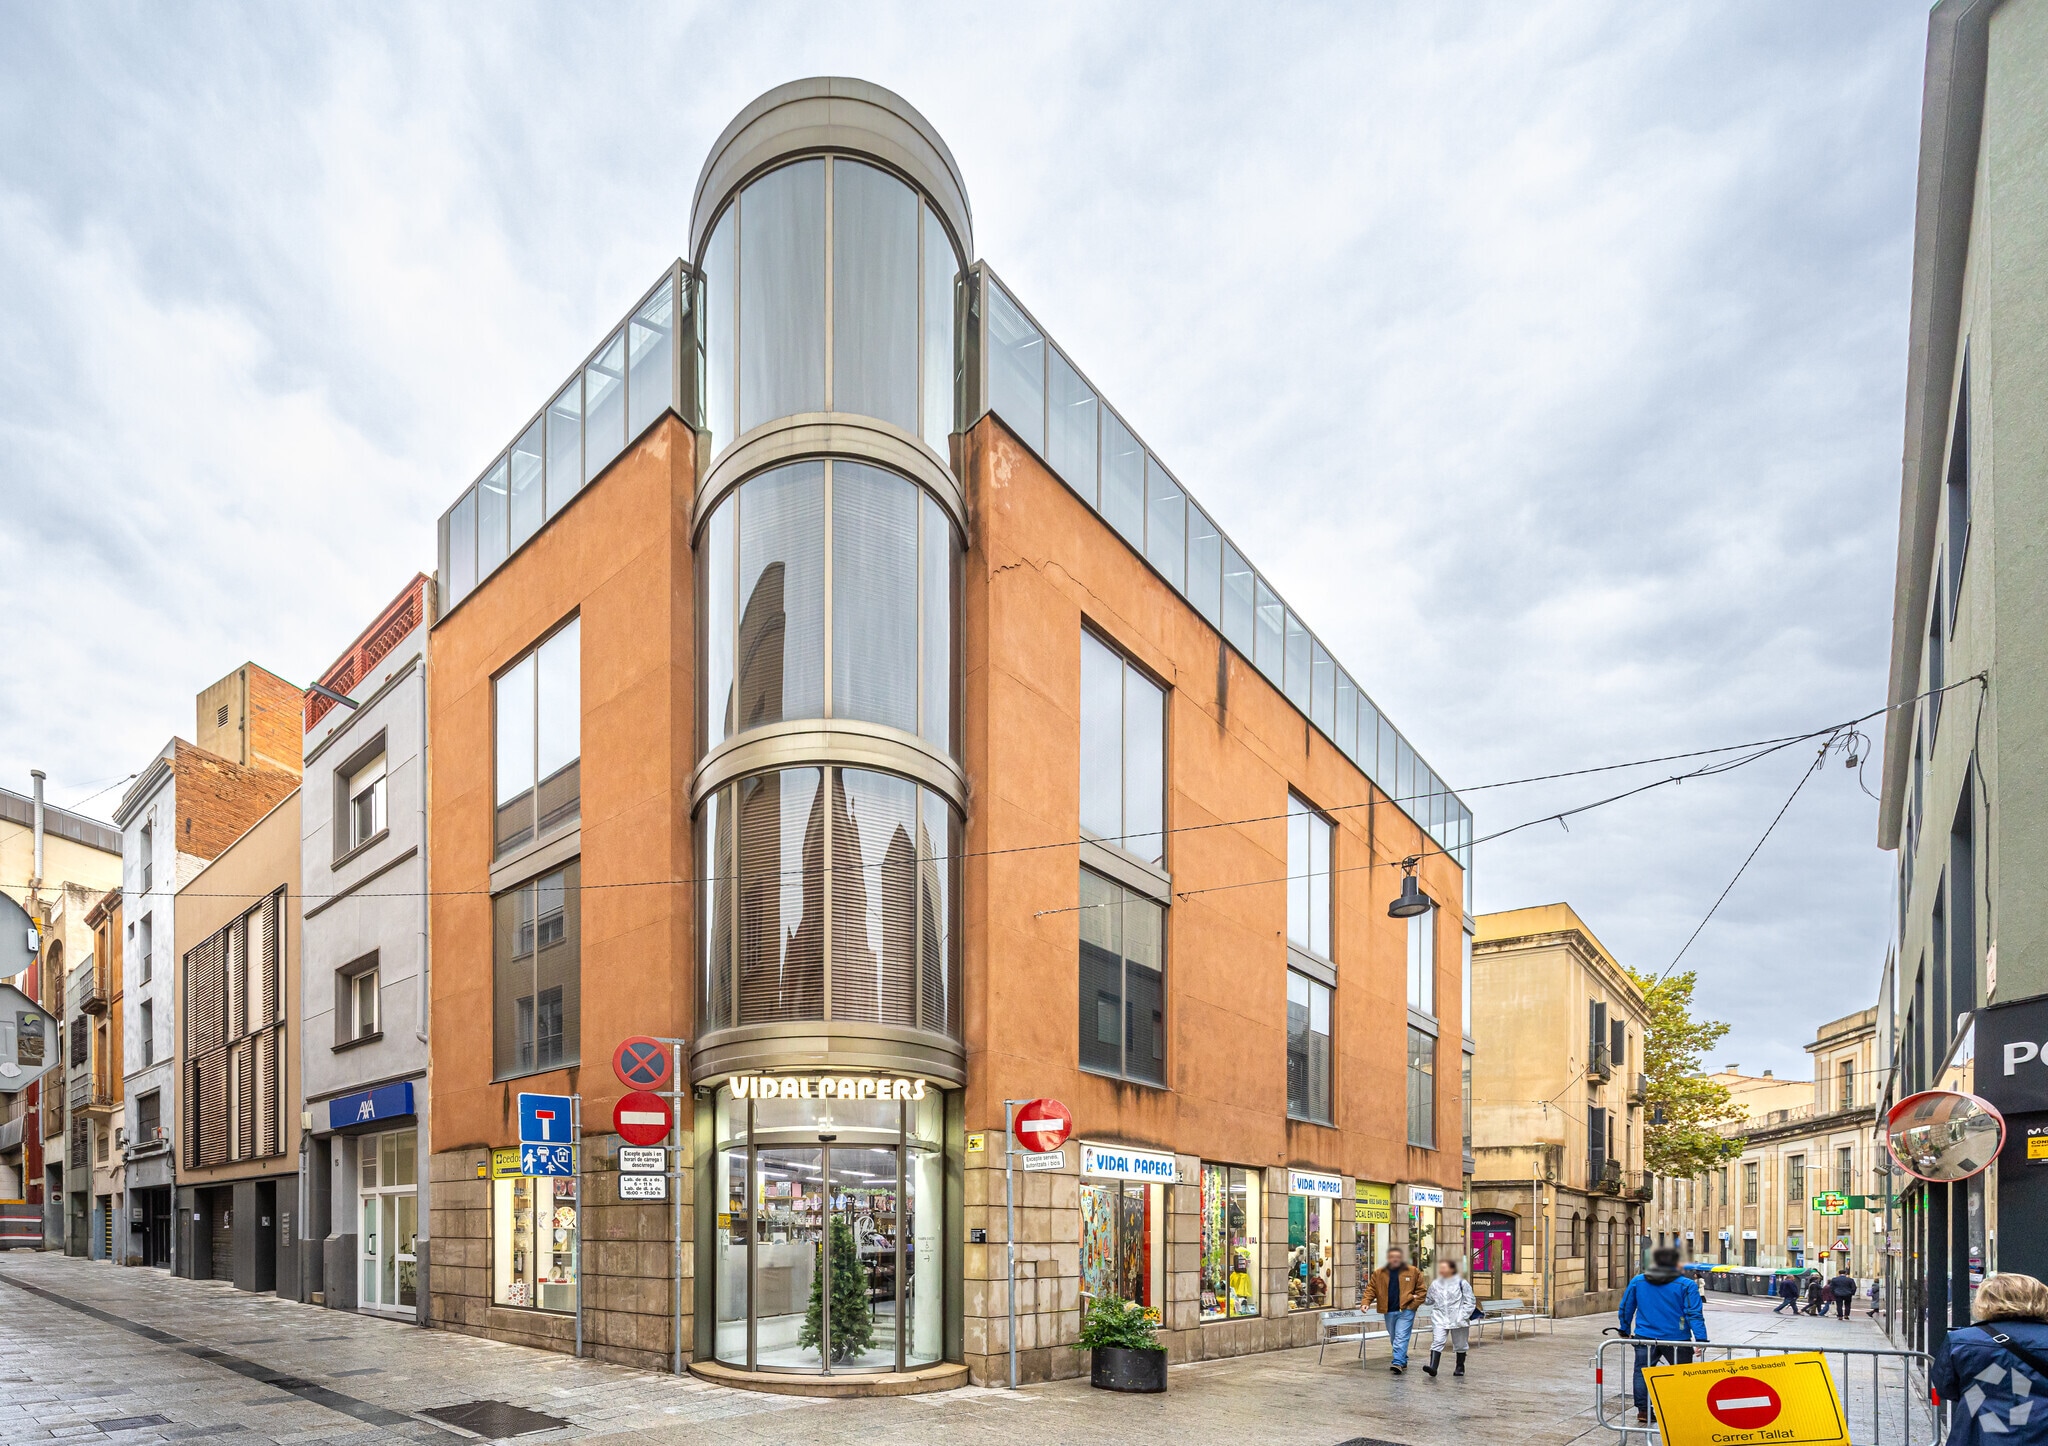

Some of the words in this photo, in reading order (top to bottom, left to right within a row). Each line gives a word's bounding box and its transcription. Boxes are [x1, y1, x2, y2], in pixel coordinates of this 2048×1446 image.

[729, 1076, 814, 1099] VIDAL
[818, 1076, 926, 1101] PAPERS
[356, 1099, 375, 1121] AXA
[1096, 1154, 1129, 1172] VIDAL
[1134, 1158, 1172, 1176] PAPERS
[1297, 1178, 1315, 1190] VIDAL
[1318, 1180, 1340, 1193] PAPERS
[1415, 1192, 1426, 1201] VIDAL
[1428, 1193, 1442, 1203] PAPERS
[1355, 1210, 1367, 1218] OCAL
[1367, 1210, 1374, 1219] EN
[1374, 1211, 1388, 1219] VENDA
[1683, 1367, 1726, 1377] Ajuntament
[1751, 1361, 1786, 1370] Sabadell
[1711, 1432, 1754, 1443] Carrer
[1756, 1429, 1795, 1440] Tallat
